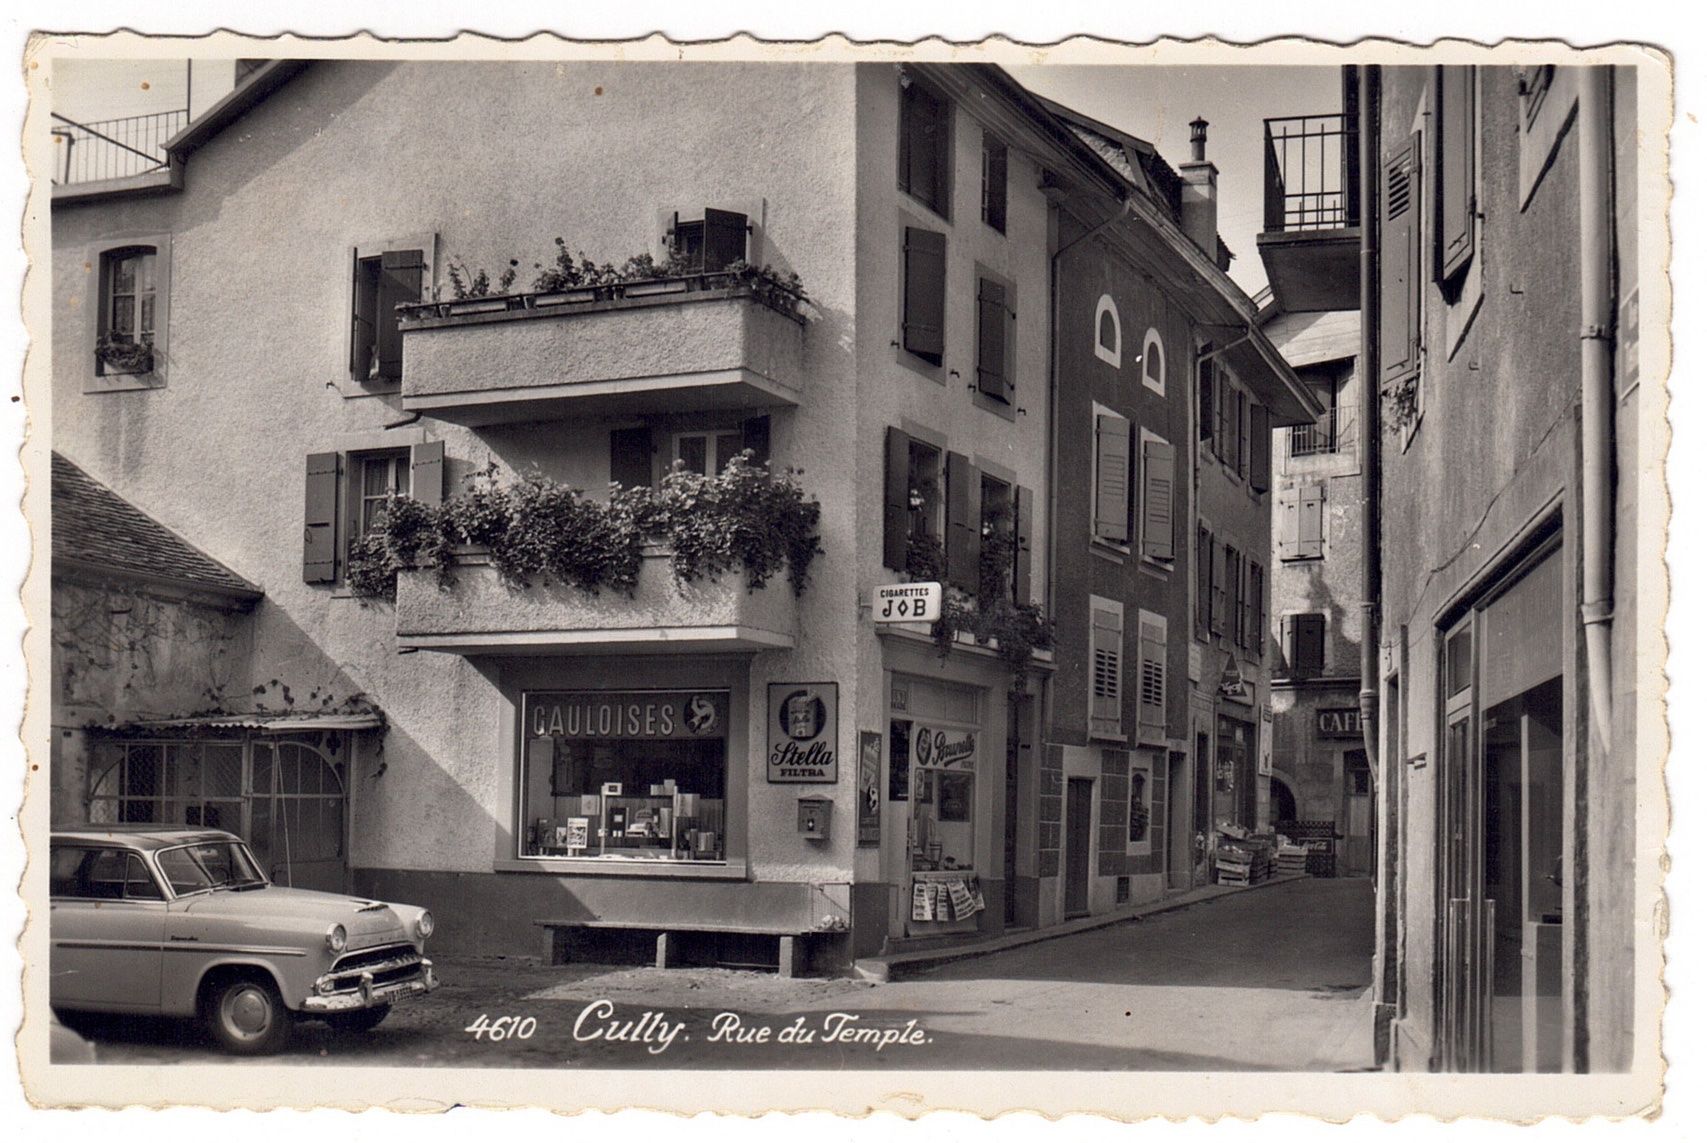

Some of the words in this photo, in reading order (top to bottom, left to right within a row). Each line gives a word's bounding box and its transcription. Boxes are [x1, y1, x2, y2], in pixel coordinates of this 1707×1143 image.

[880, 587, 930, 598] CIGARETTES
[882, 598, 927, 618] JOB
[532, 704, 675, 737] GAULOISES
[770, 740, 834, 766] Stella
[780, 768, 825, 777] FILTRA
